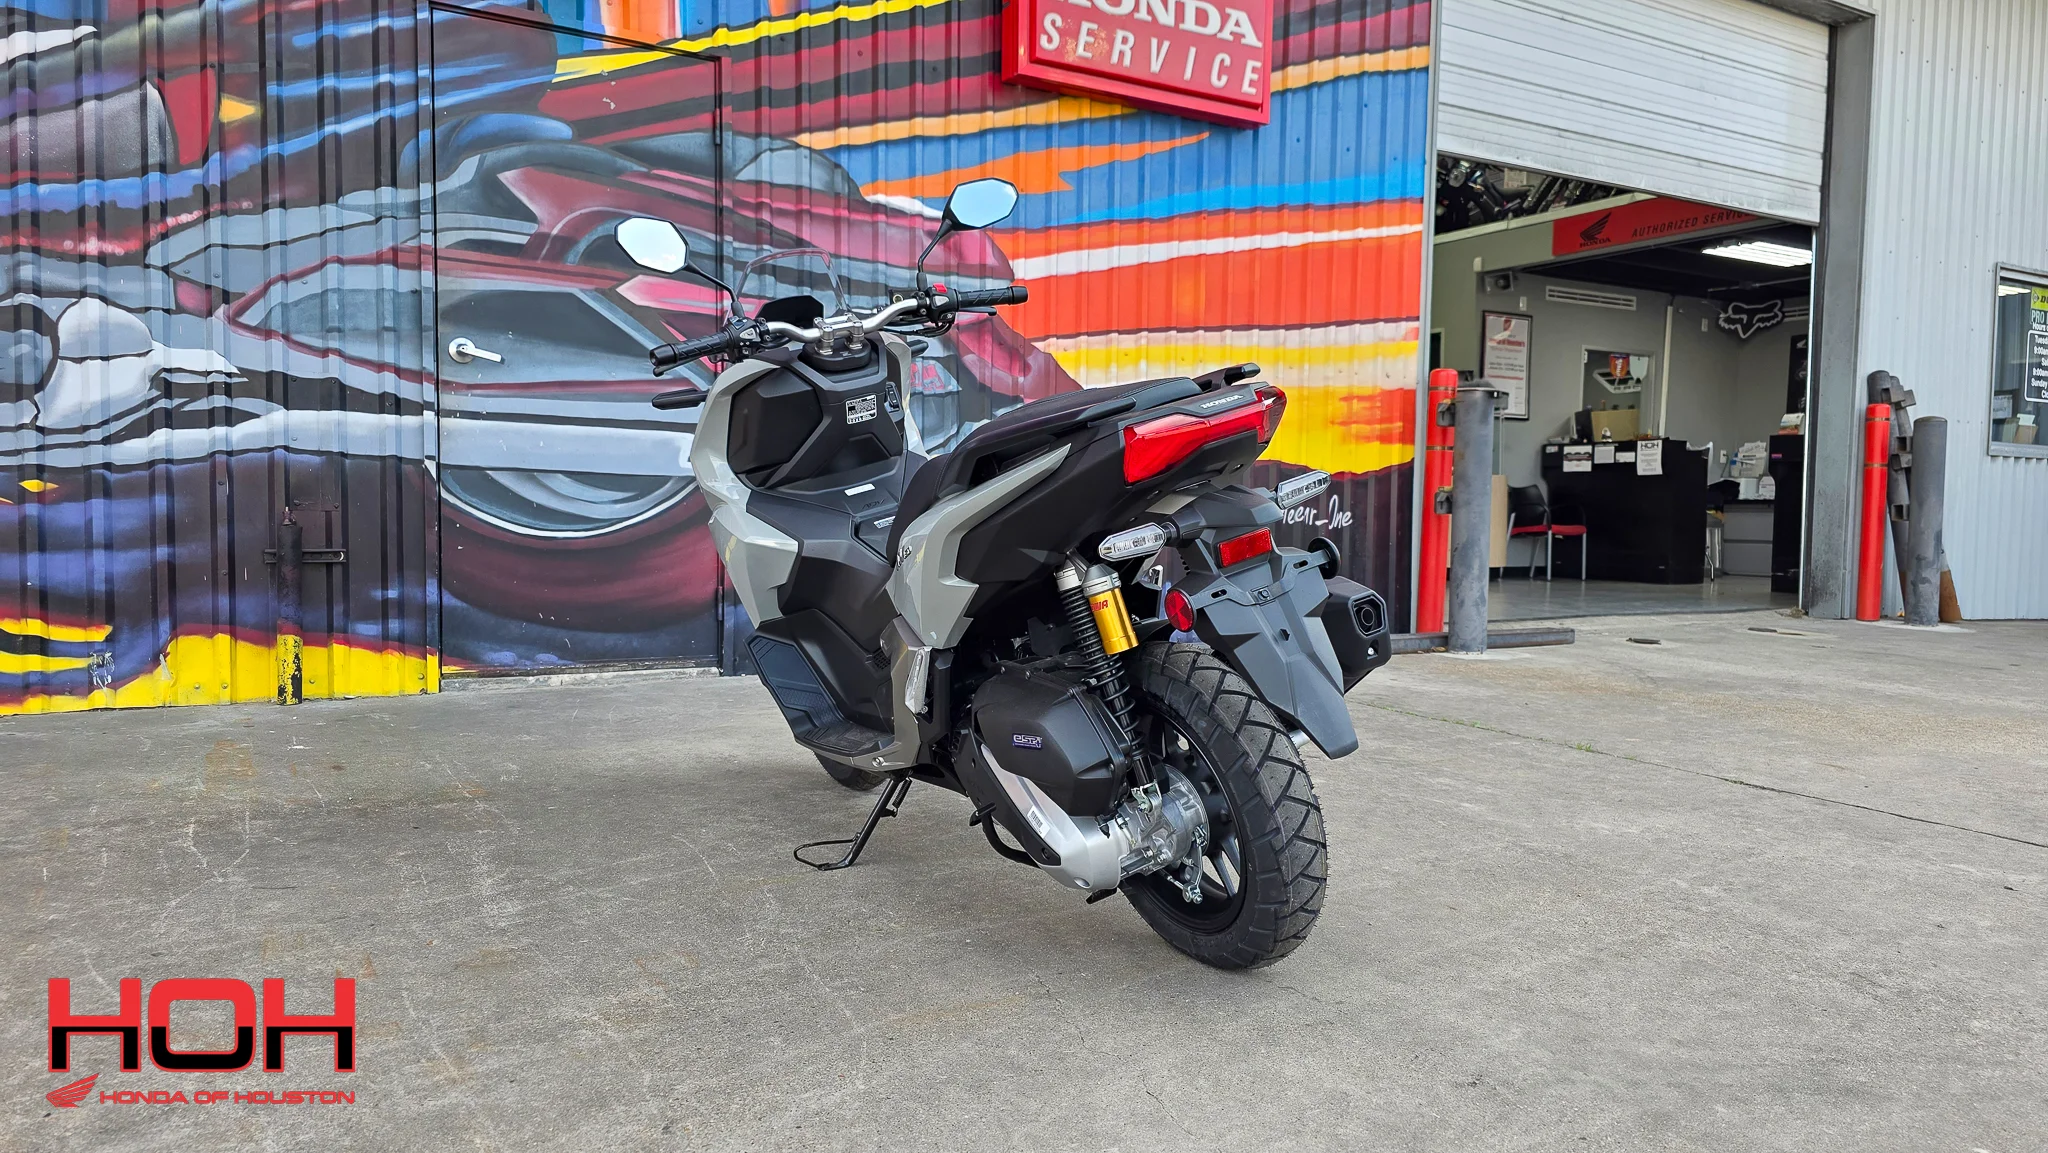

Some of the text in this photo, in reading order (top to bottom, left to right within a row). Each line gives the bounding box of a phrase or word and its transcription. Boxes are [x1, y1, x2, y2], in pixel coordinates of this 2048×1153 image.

[1039, 12, 1263, 96] SERVICE
[1631, 217, 1699, 238] AUTHORIZED
[1579, 236, 1612, 249] HONDA
[2031, 310, 2045, 324] PRO
[2031, 378, 2048, 390] Sunday
[1200, 395, 1244, 409] HONDA
